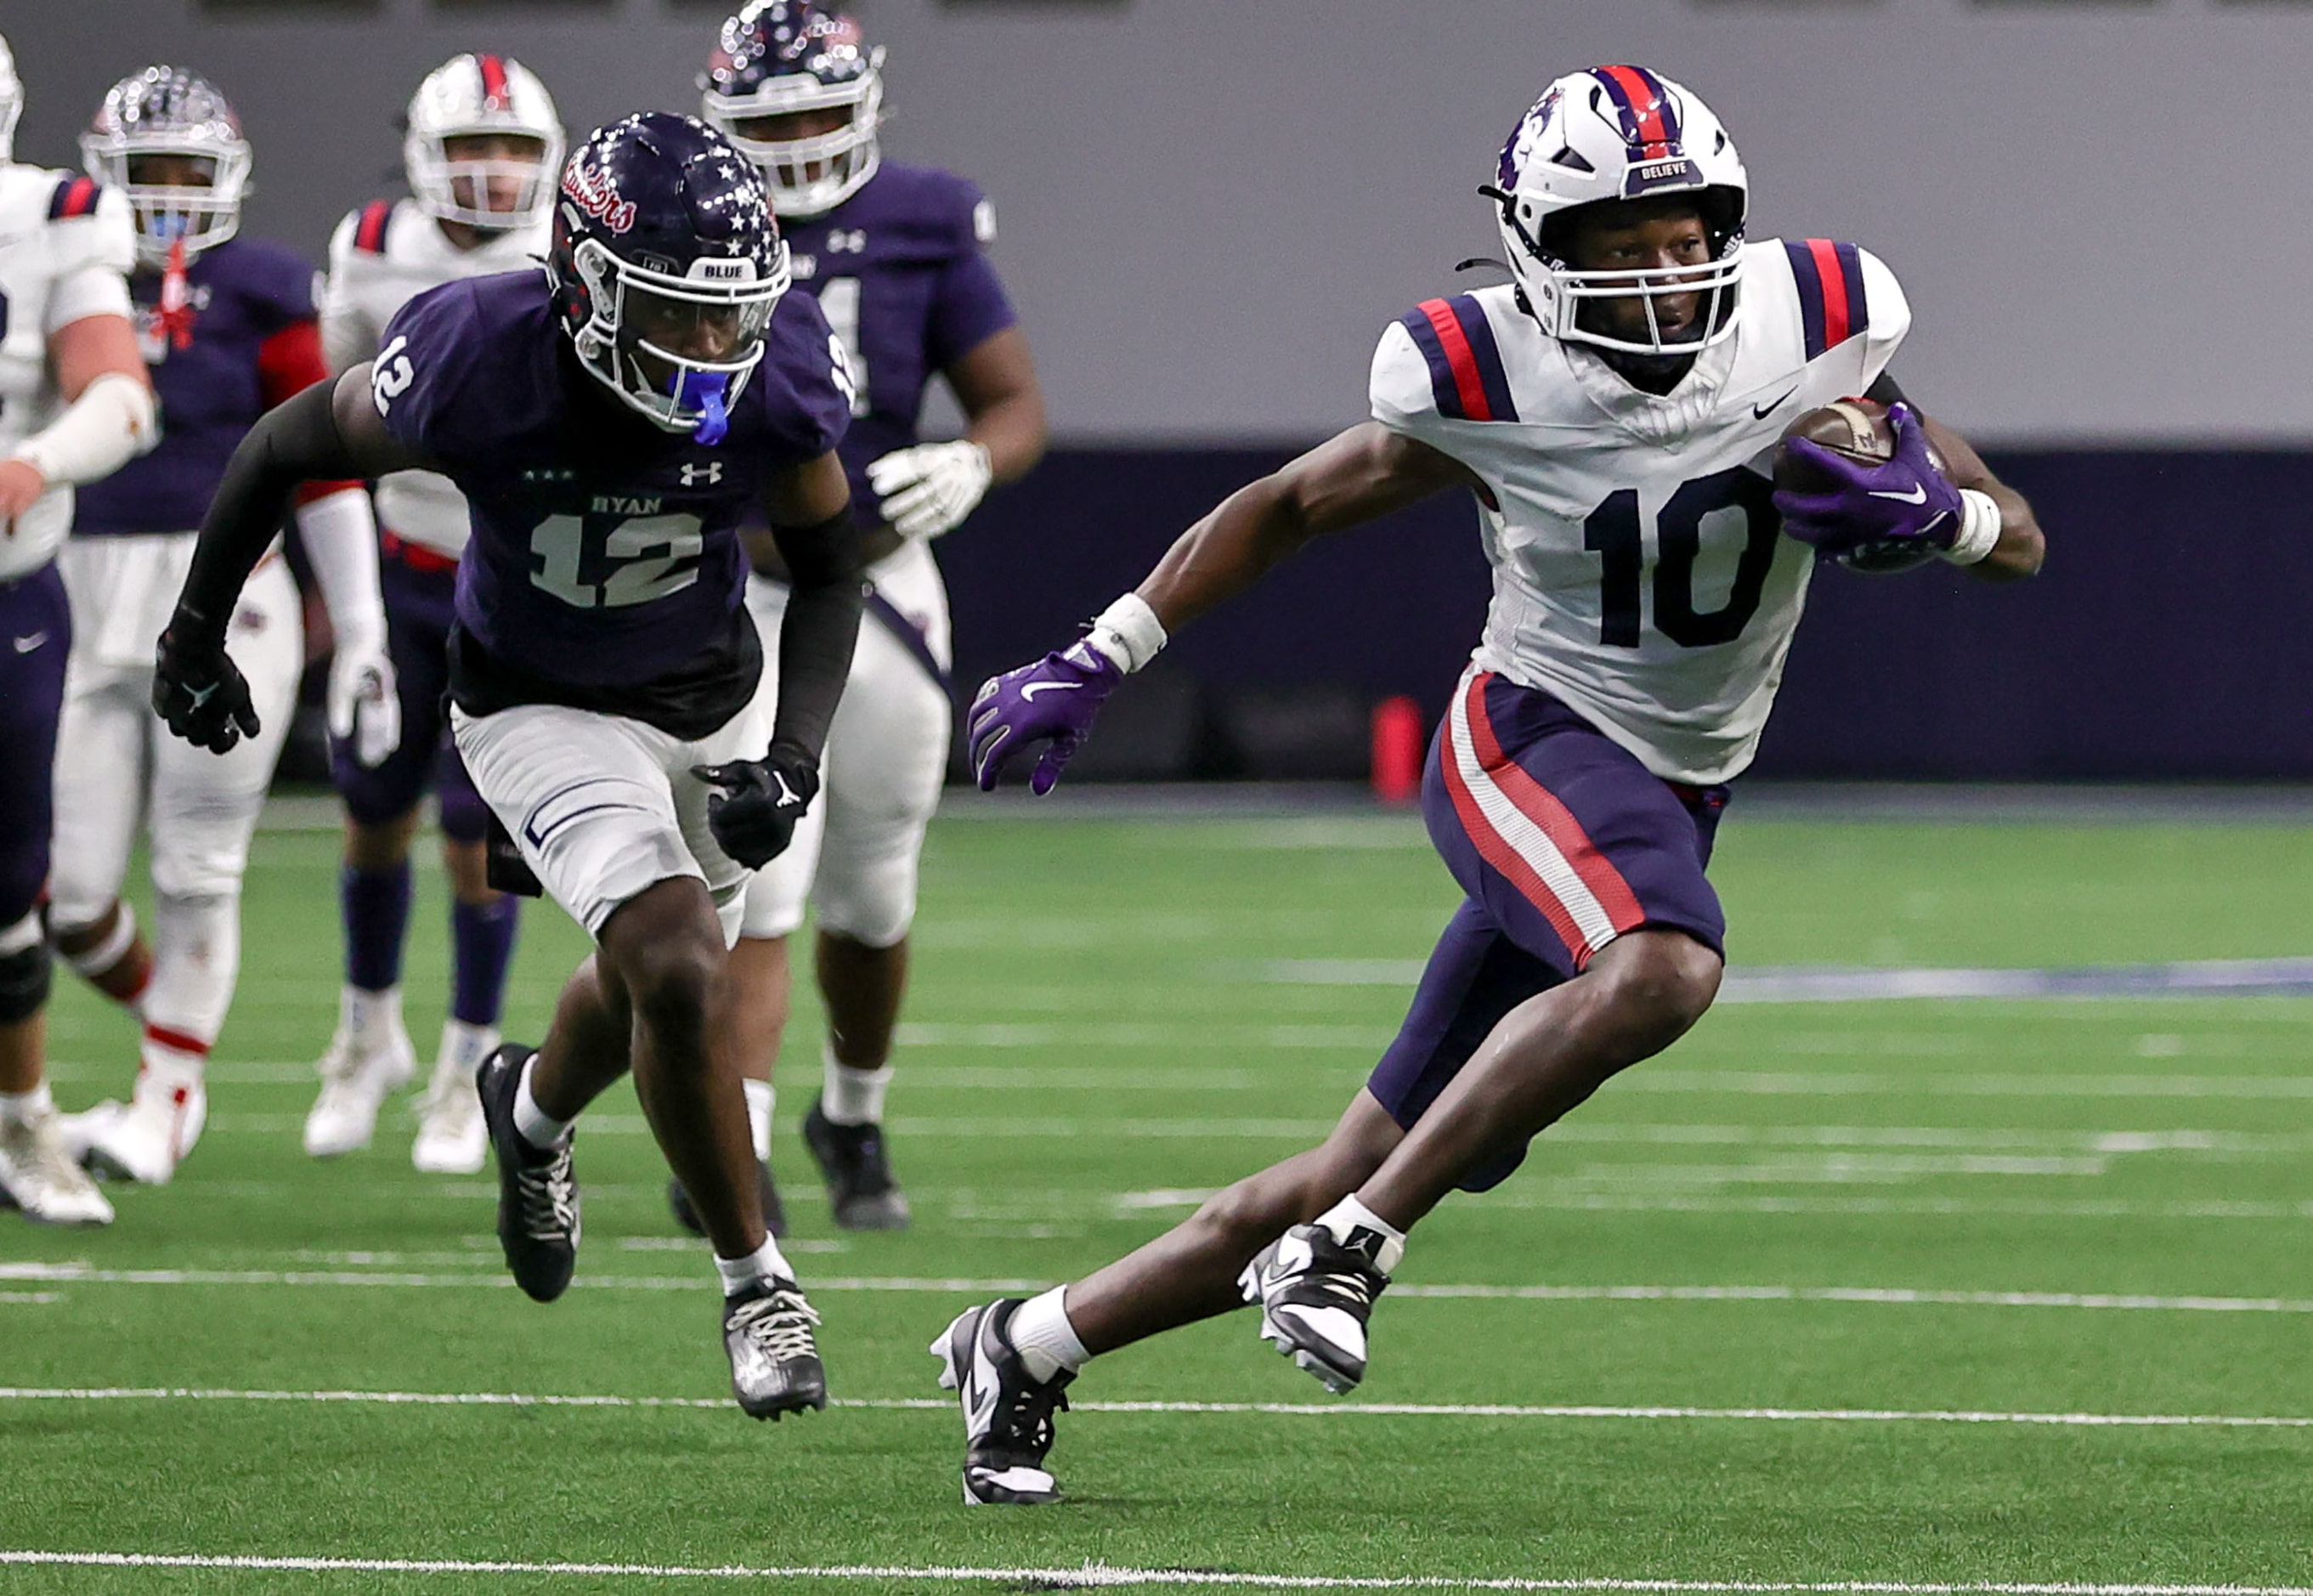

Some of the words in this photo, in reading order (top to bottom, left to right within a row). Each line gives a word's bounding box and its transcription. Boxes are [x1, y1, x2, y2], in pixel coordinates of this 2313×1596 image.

[1641, 161, 1687, 180] BELIEVE
[704, 264, 744, 279] BLUE
[371, 335, 415, 417] 12
[591, 496, 662, 513] RYAN
[529, 512, 704, 608] 12
[1584, 464, 1782, 648] 10
